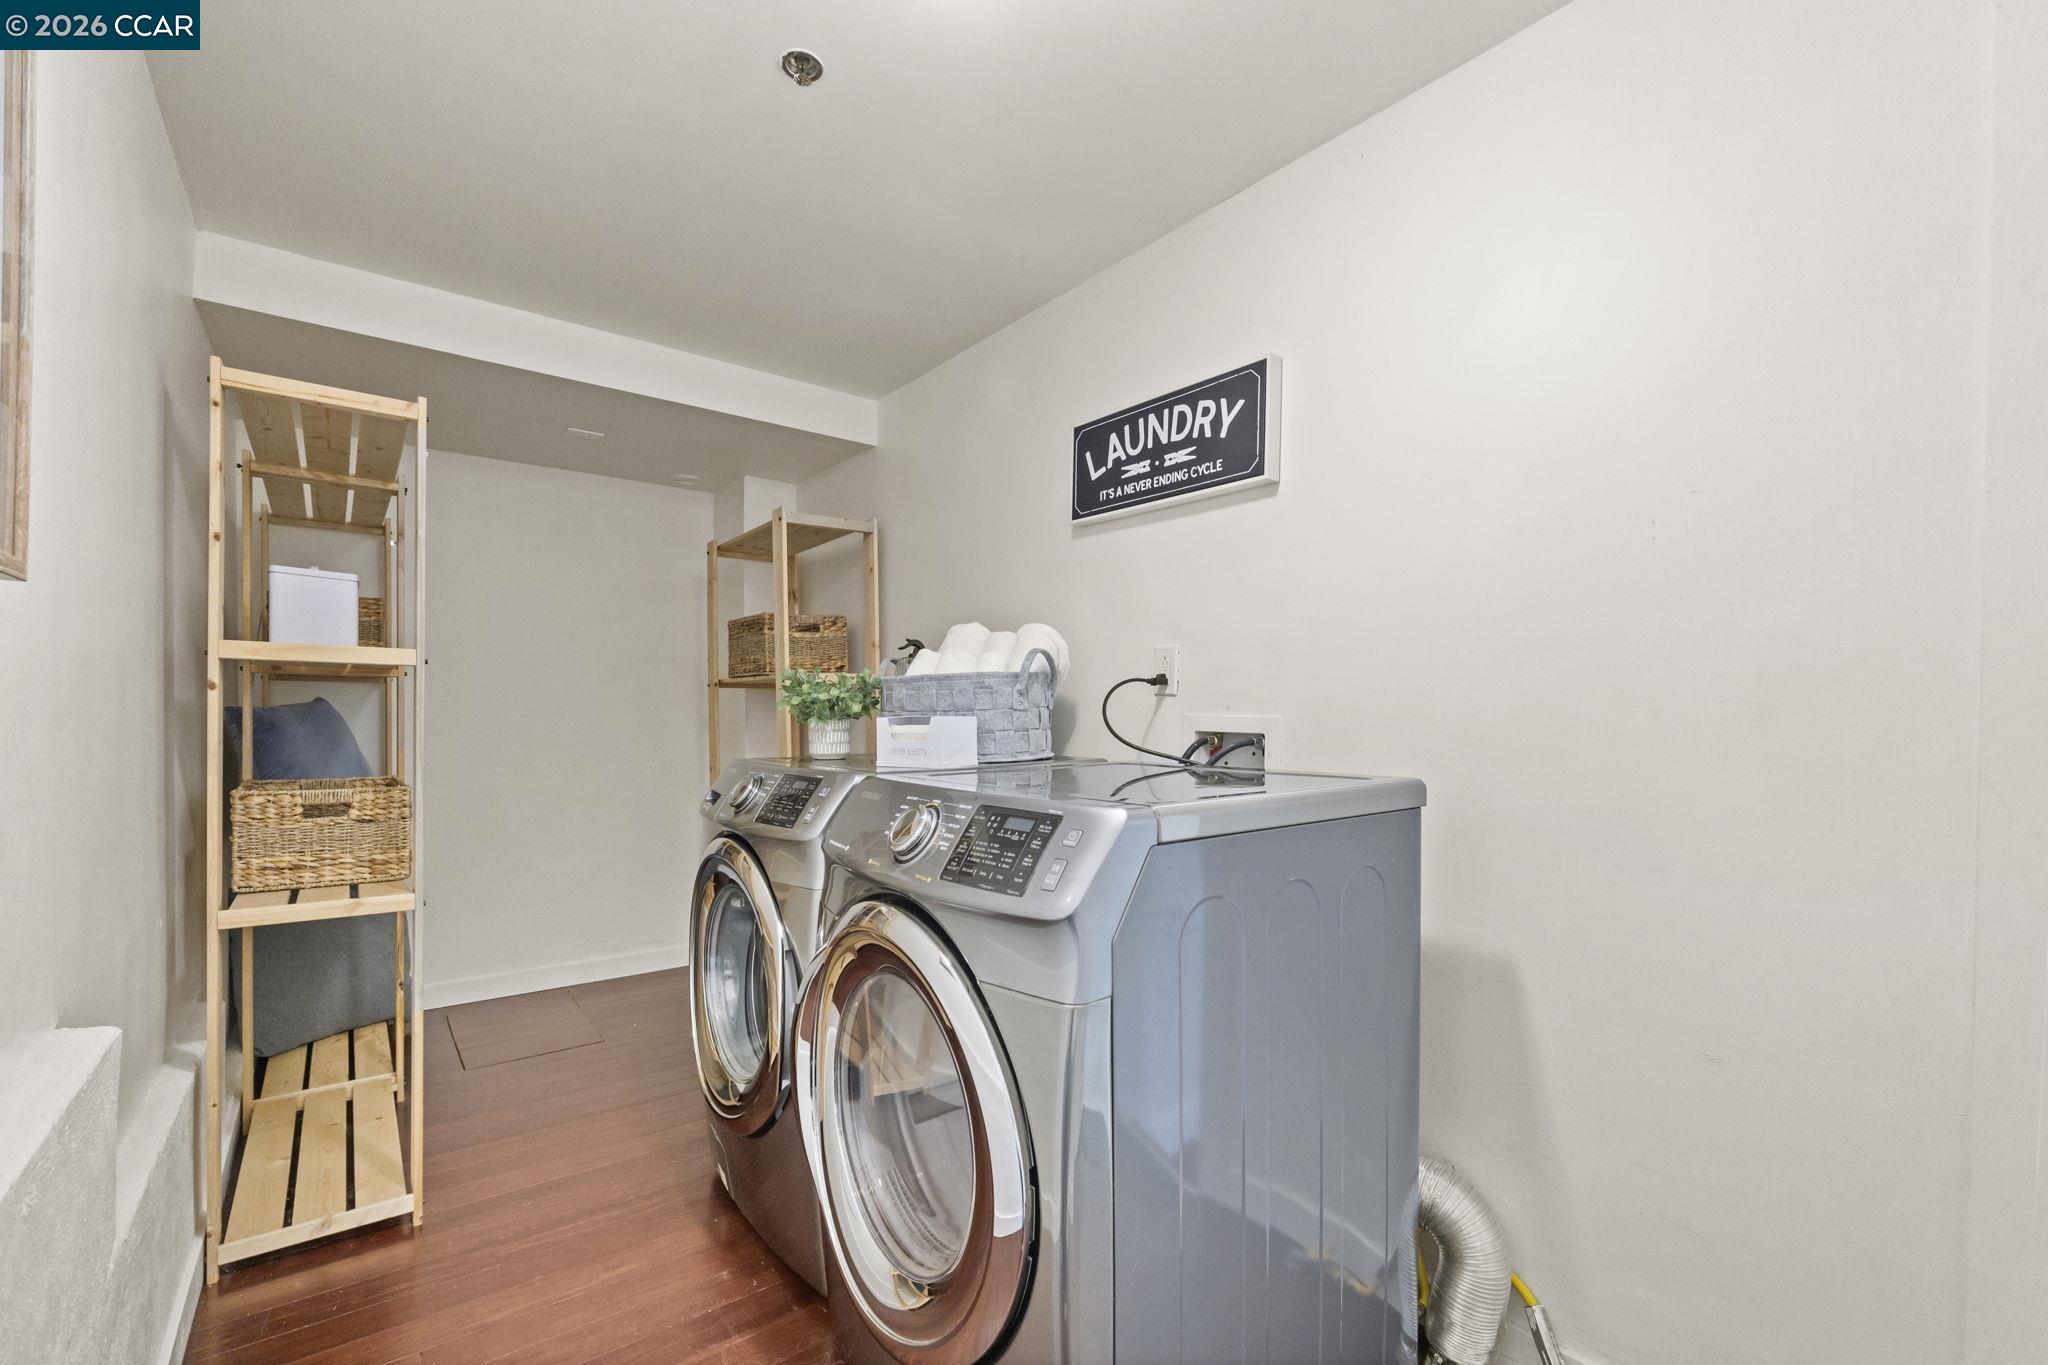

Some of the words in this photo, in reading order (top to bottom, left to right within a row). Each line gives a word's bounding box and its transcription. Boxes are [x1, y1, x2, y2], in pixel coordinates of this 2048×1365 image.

[1085, 398, 1245, 481] LAUNDRY
[1100, 488, 1115, 502] IT'S
[1115, 486, 1123, 497] A
[1123, 478, 1152, 495] NEVER
[1153, 473, 1188, 488] ENDING
[1190, 459, 1223, 478] CYCLE
[889, 747, 906, 756] DRYER
[907, 747, 927, 756] SHEETS
